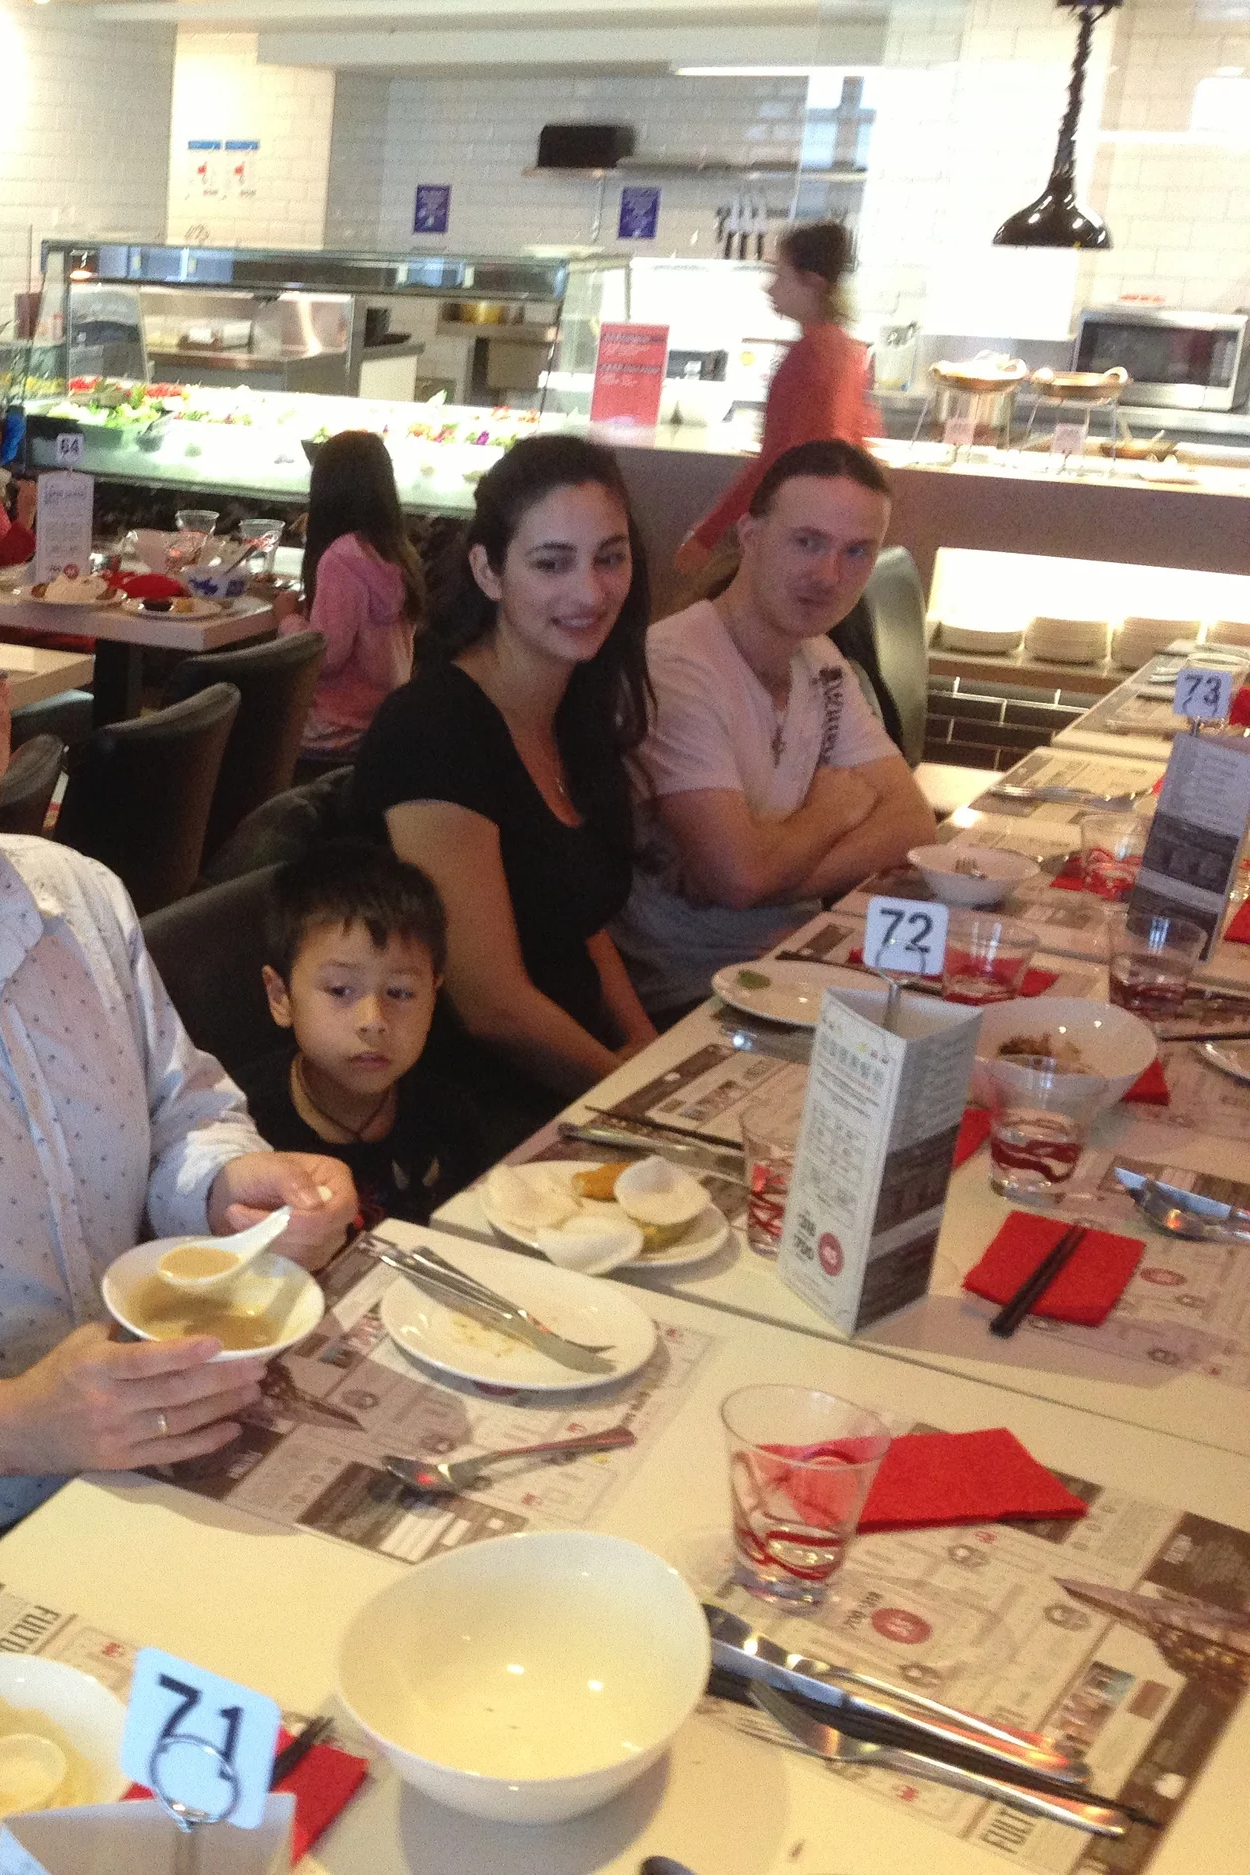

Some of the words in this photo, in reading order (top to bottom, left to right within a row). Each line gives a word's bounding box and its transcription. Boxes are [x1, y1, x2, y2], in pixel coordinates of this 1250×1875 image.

[1184, 673, 1222, 706] 73
[880, 907, 933, 954] 72
[156, 1672, 245, 1782] 71
